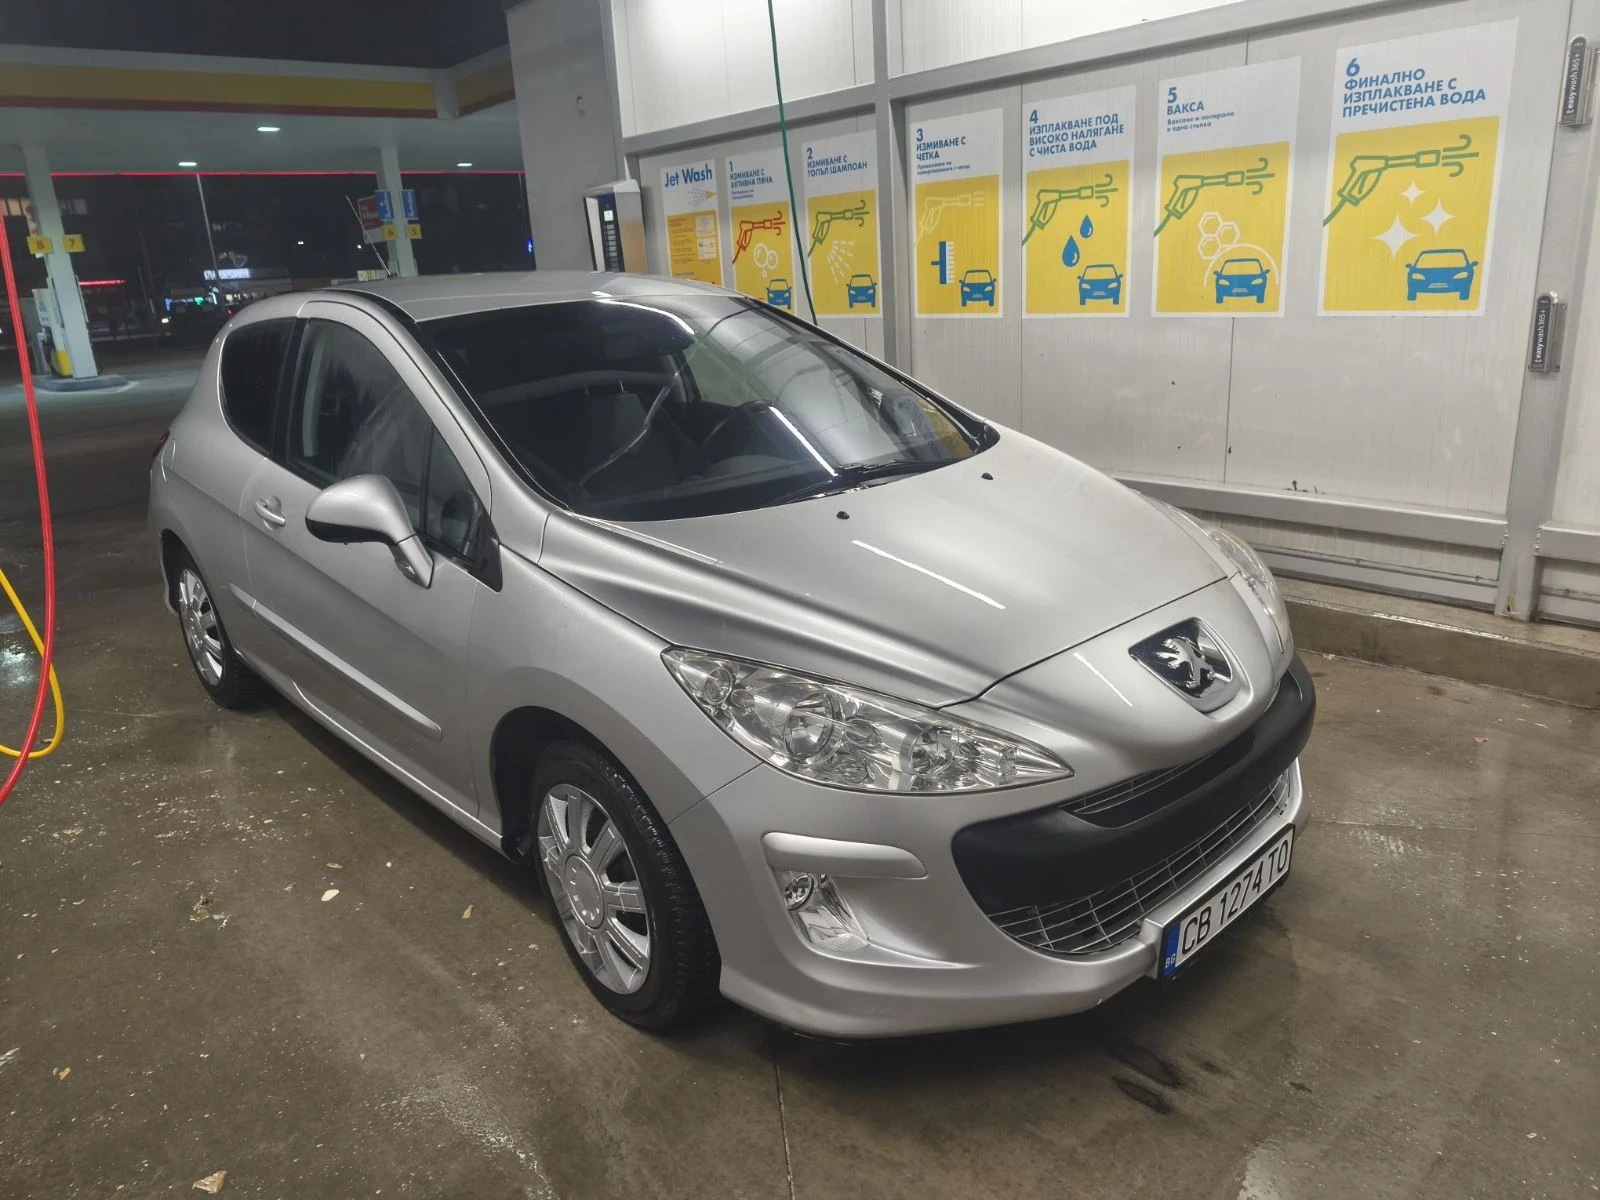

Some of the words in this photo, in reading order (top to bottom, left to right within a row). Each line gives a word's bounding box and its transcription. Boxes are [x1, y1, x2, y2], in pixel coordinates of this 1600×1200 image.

[1345, 57, 1361, 77] 6
[1344, 68, 1425, 91] ФИНАЛНО
[1167, 86, 1178, 104] 5
[1343, 79, 1444, 105] ИЗПЛАКВАНЕ
[1447, 77, 1457, 90] С
[1167, 100, 1205, 116] ВАКСА
[1342, 95, 1436, 118] ПРЕЧИСТЕНА
[1439, 88, 1486, 105] ВОДА
[1029, 109, 1039, 124] 4
[1029, 117, 1093, 136] ИЗПЛАКВАНЕ
[1095, 113, 1119, 125] ПОД
[916, 128, 924, 142] 3
[1029, 132, 1069, 147] ВИСОКО
[1071, 124, 1124, 141] НАЛЯГАНЕ
[916, 137, 959, 152] ИЗМИВАНЕ
[960, 136, 966, 145] С
[1029, 147, 1035, 158] С
[1037, 144, 1067, 156] ЧИСТА
[1069, 140, 1097, 153] ВОДА
[806, 147, 813, 160] 2
[807, 155, 842, 169] ИЗМИВАНЕ
[843, 154, 848, 163] С
[916, 150, 940, 162] ЧЕТКА
[729, 160, 734, 172] 1
[807, 167, 829, 178] ТОПЪЛ
[830, 161, 868, 174] ШАМПОАН
[664, 171, 680, 188] Jet
[682, 163, 713, 185] Wash
[730, 169, 760, 181] ИЗМИВАНЕ
[760, 168, 765, 177] С
[730, 178, 756, 189] АКТИВНА
[756, 176, 773, 185] ПЯНА
[36, 239, 45, 251] 8
[69, 238, 76, 249] 7
[1181, 905, 1212, 955] CB
[1219, 860, 1264, 926] 1274
[1268, 839, 1289, 884] TO
[1164, 953, 1176, 969] BG
